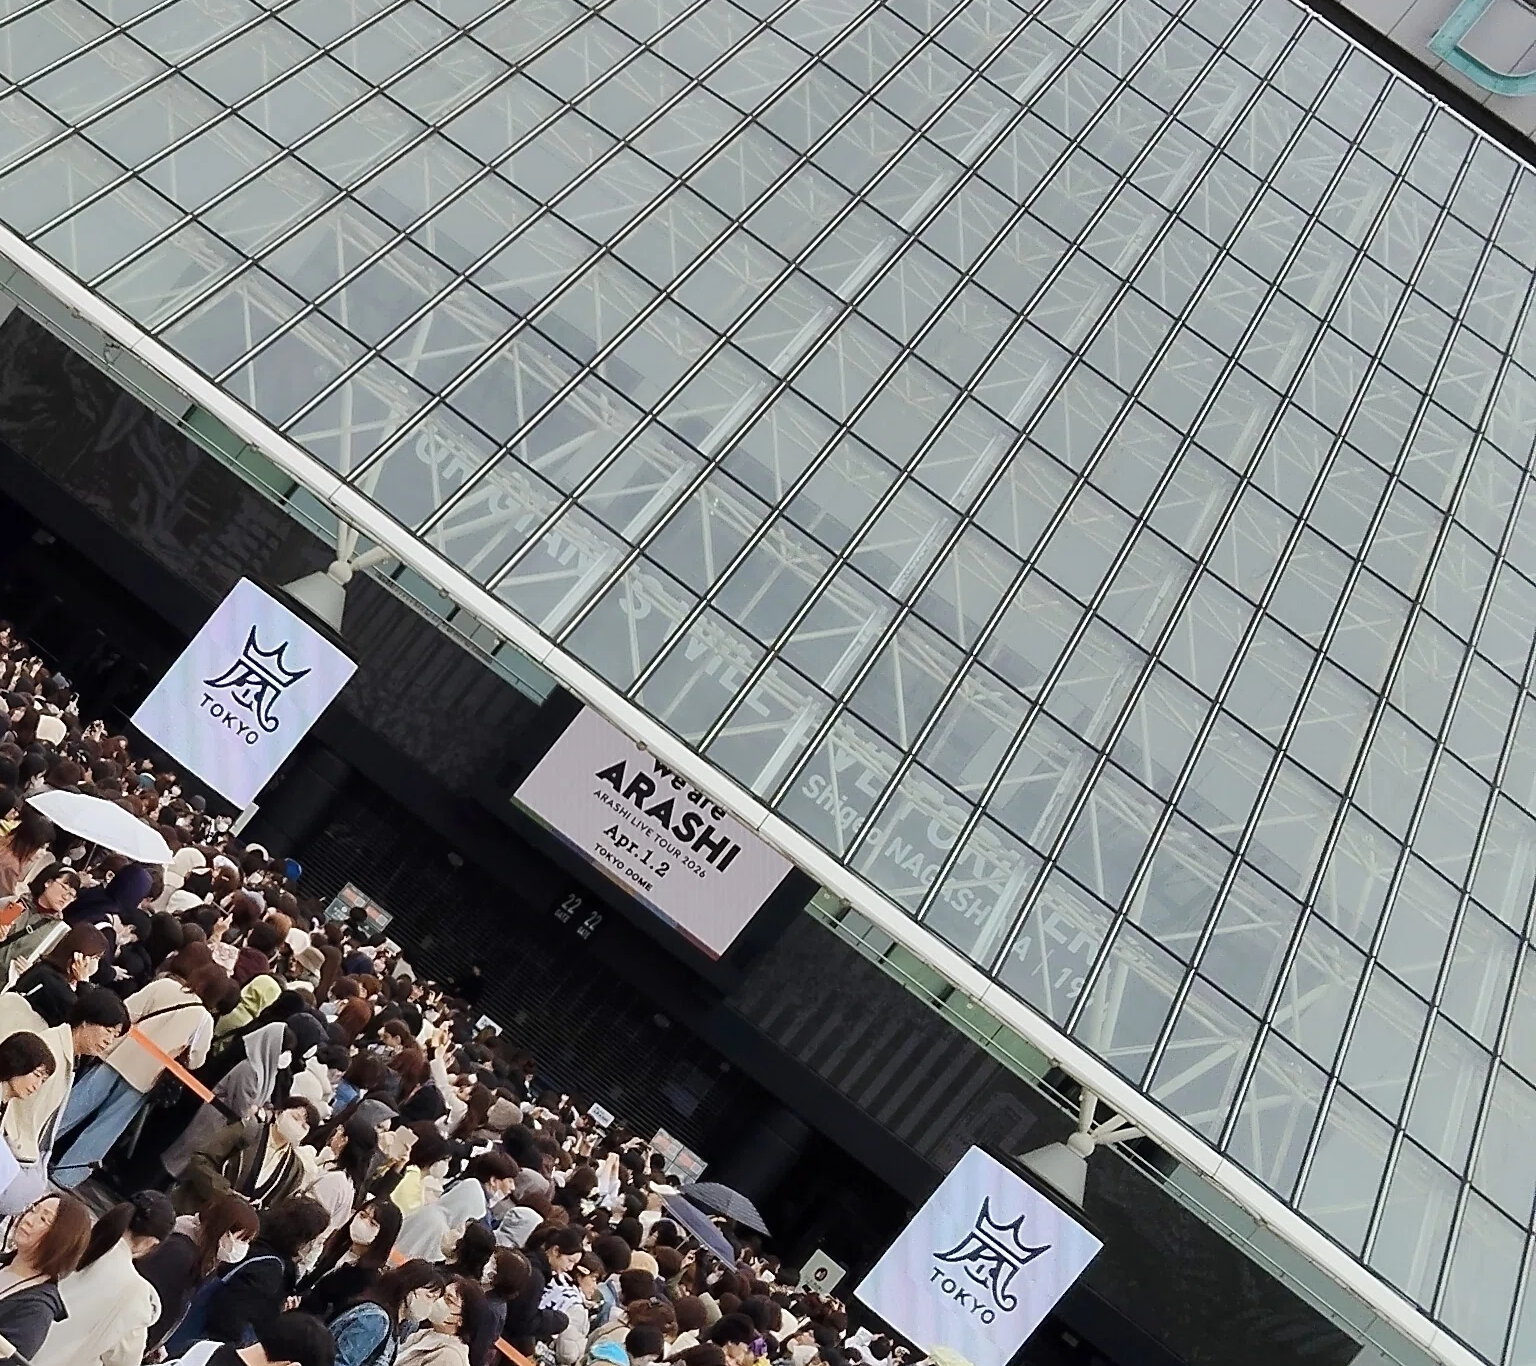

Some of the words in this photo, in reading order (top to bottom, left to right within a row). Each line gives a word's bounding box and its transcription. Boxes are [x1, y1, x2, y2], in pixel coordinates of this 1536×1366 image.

[199, 692, 259, 746] TOKYO
[595, 759, 742, 873] ARASHI
[687, 788, 727, 821] are
[593, 789, 632, 821] ARASHI
[630, 815, 654, 837] LIVE
[653, 833, 682, 859] TOUR
[681, 855, 707, 879] 2026
[594, 842, 624, 871] TOKYO
[624, 867, 654, 892] DOME
[560, 891, 583, 915] 22
[582, 909, 604, 932] 22
[883, 836, 1032, 961] NAGASHA
[929, 1266, 996, 1325] TOKYO
